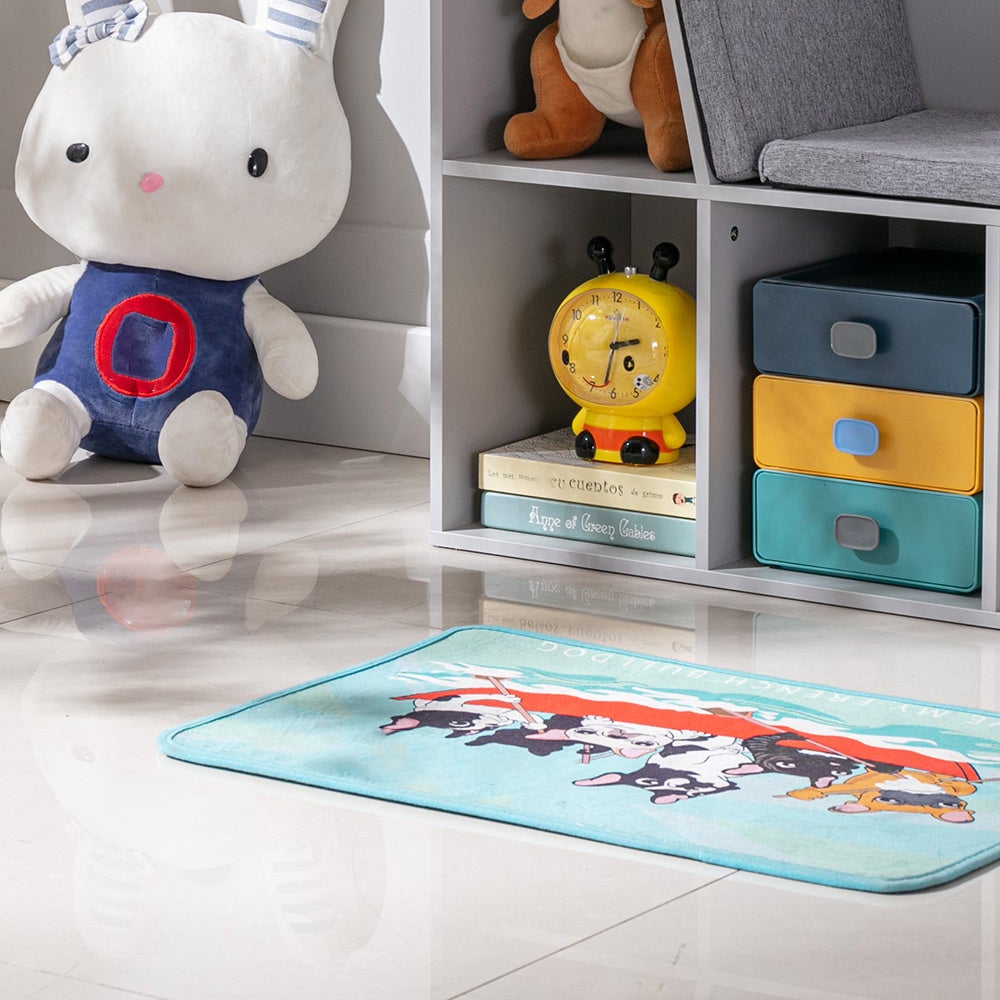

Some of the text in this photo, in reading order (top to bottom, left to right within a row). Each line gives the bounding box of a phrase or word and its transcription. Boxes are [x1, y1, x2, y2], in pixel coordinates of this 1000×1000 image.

[591, 294, 599, 306] 11
[612, 291, 623, 303] 12
[572, 309, 582, 321] 10
[568, 477, 624, 497] cuentos
[528, 505, 656, 542] Anne of Green Gables
[536, 640, 707, 679] BULLDOG
[725, 671, 875, 706] FRENCH
[892, 705, 949, 719] MY
